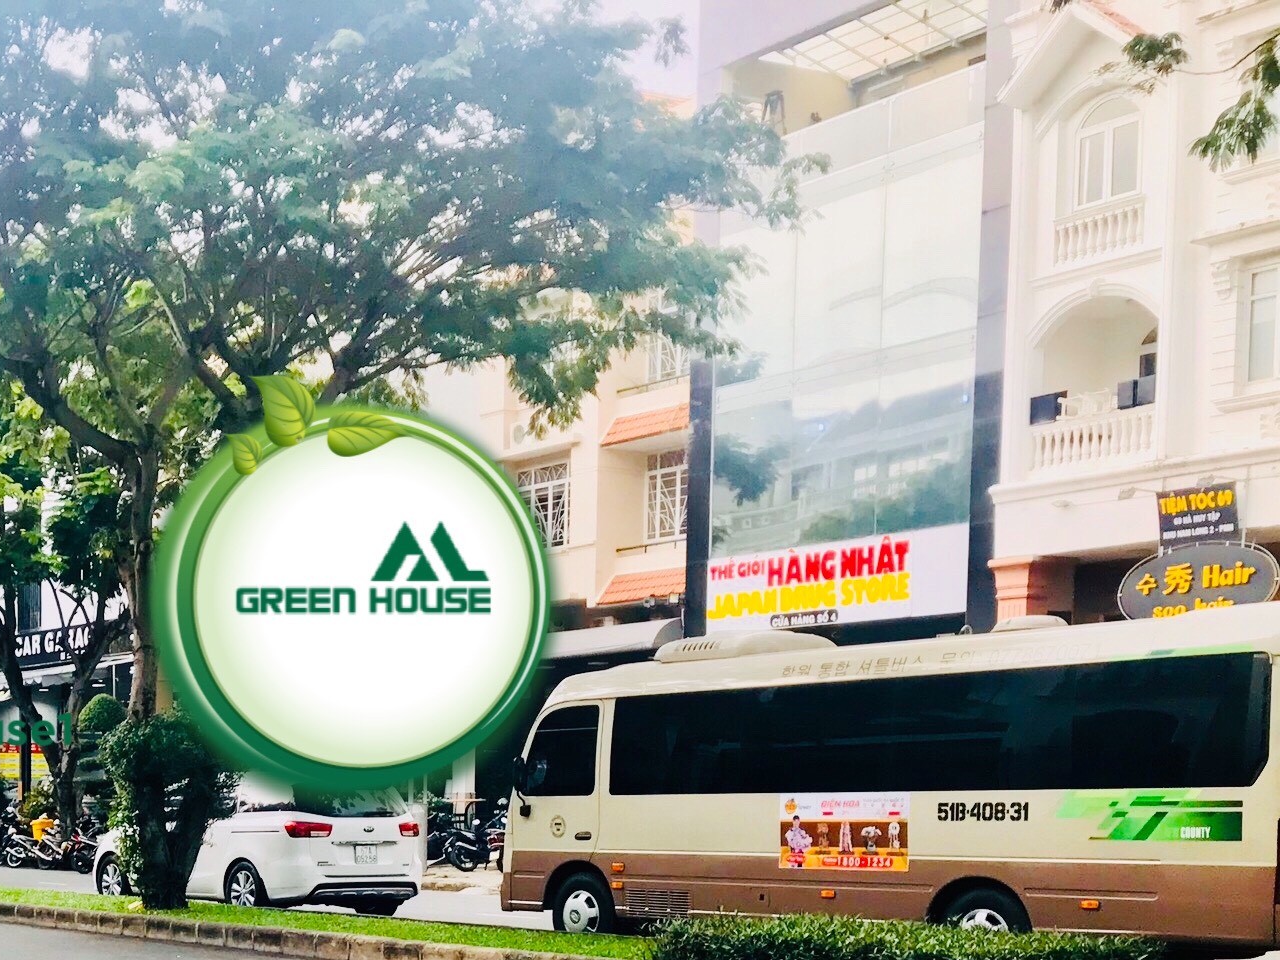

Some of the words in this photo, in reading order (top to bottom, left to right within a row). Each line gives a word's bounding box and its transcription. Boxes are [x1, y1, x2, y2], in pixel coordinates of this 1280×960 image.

[767, 548, 837, 587] HÀNG
[840, 535, 910, 579] NHẬT
[1201, 560, 1257, 588] Hair
[707, 588, 778, 619] JAPAN
[780, 580, 837, 612] DRUG
[840, 572, 911, 606] STORE
[14, 633, 41, 657] CAR
[1180, 826, 1211, 839] COUNTY
